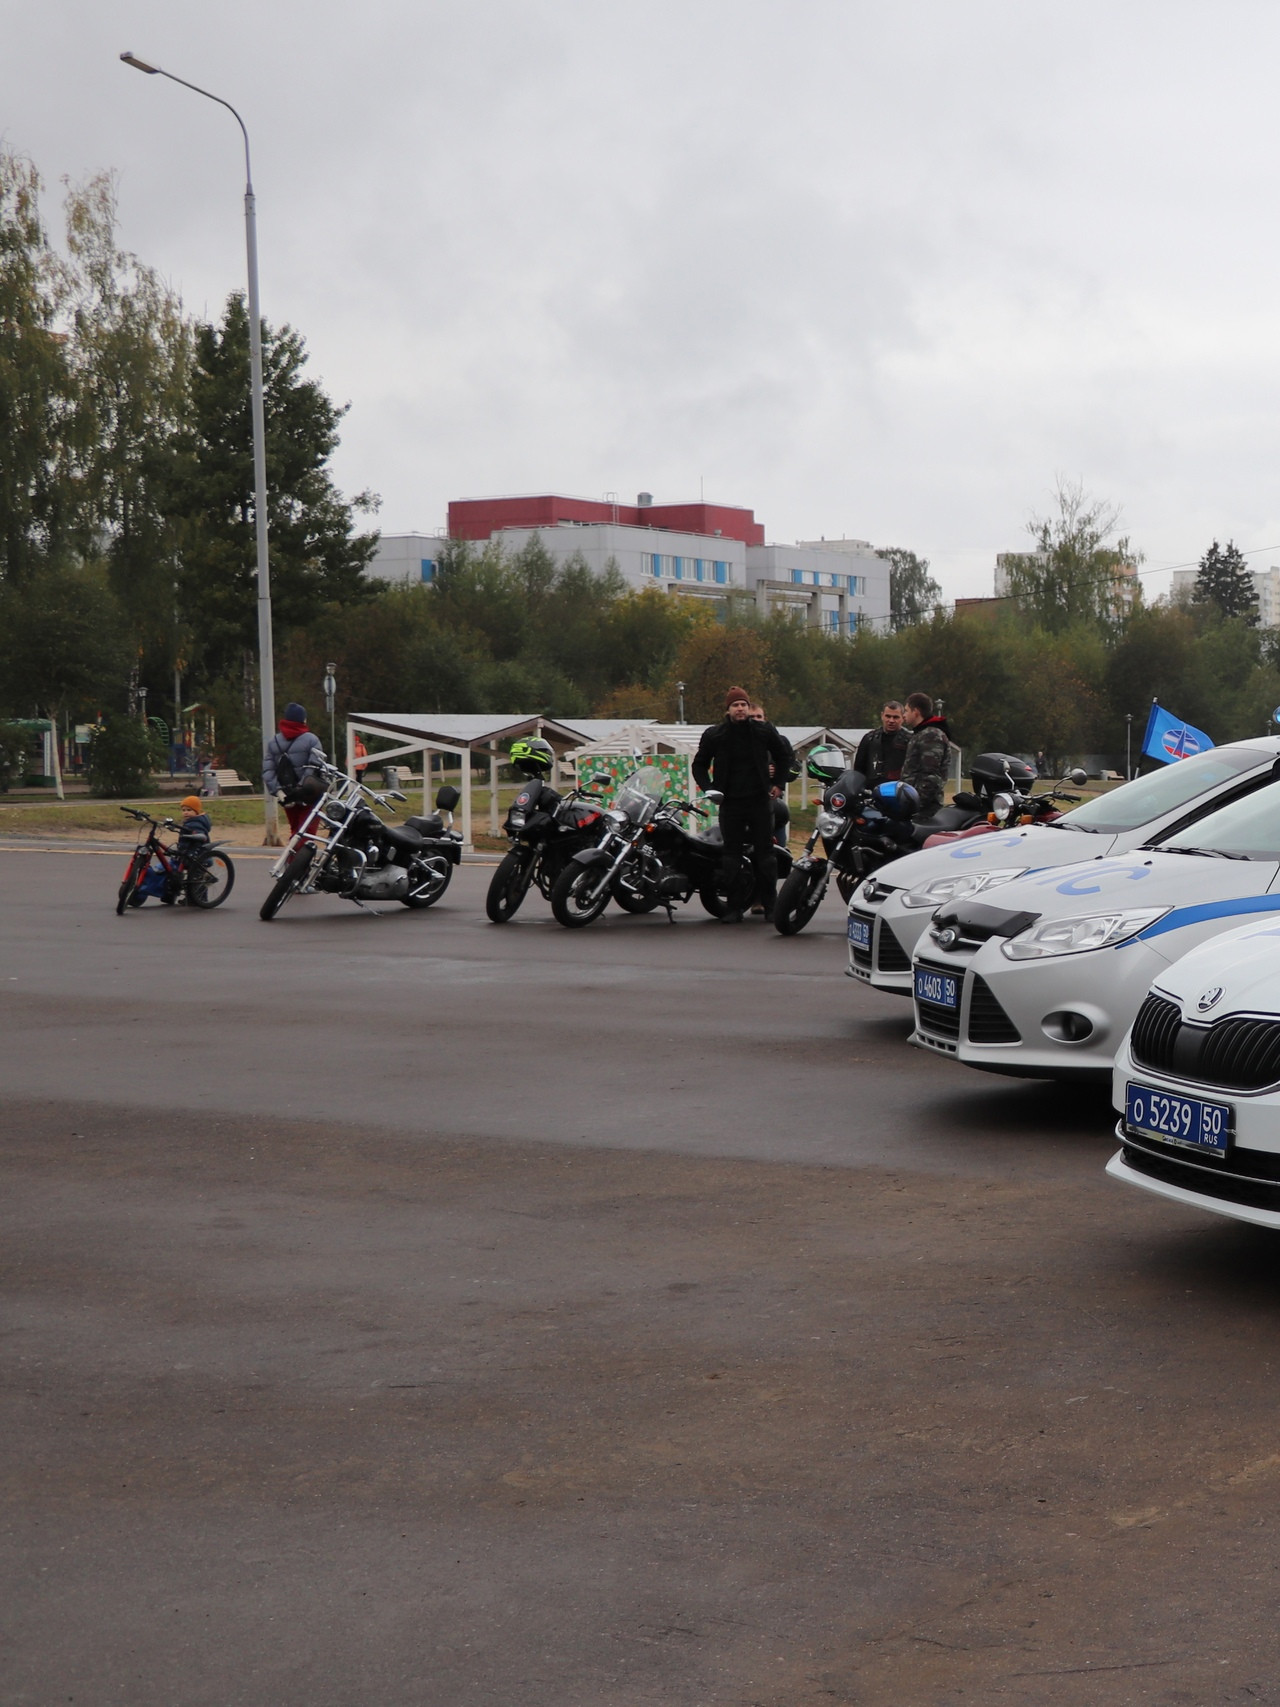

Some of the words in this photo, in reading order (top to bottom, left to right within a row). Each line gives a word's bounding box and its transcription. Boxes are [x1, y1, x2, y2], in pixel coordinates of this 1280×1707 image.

[924, 975, 942, 1000] 4603
[945, 978, 955, 997] 50
[1149, 1094, 1192, 1136] 5239
[1202, 1106, 1221, 1135] 50
[1203, 1133, 1218, 1145] RUS
